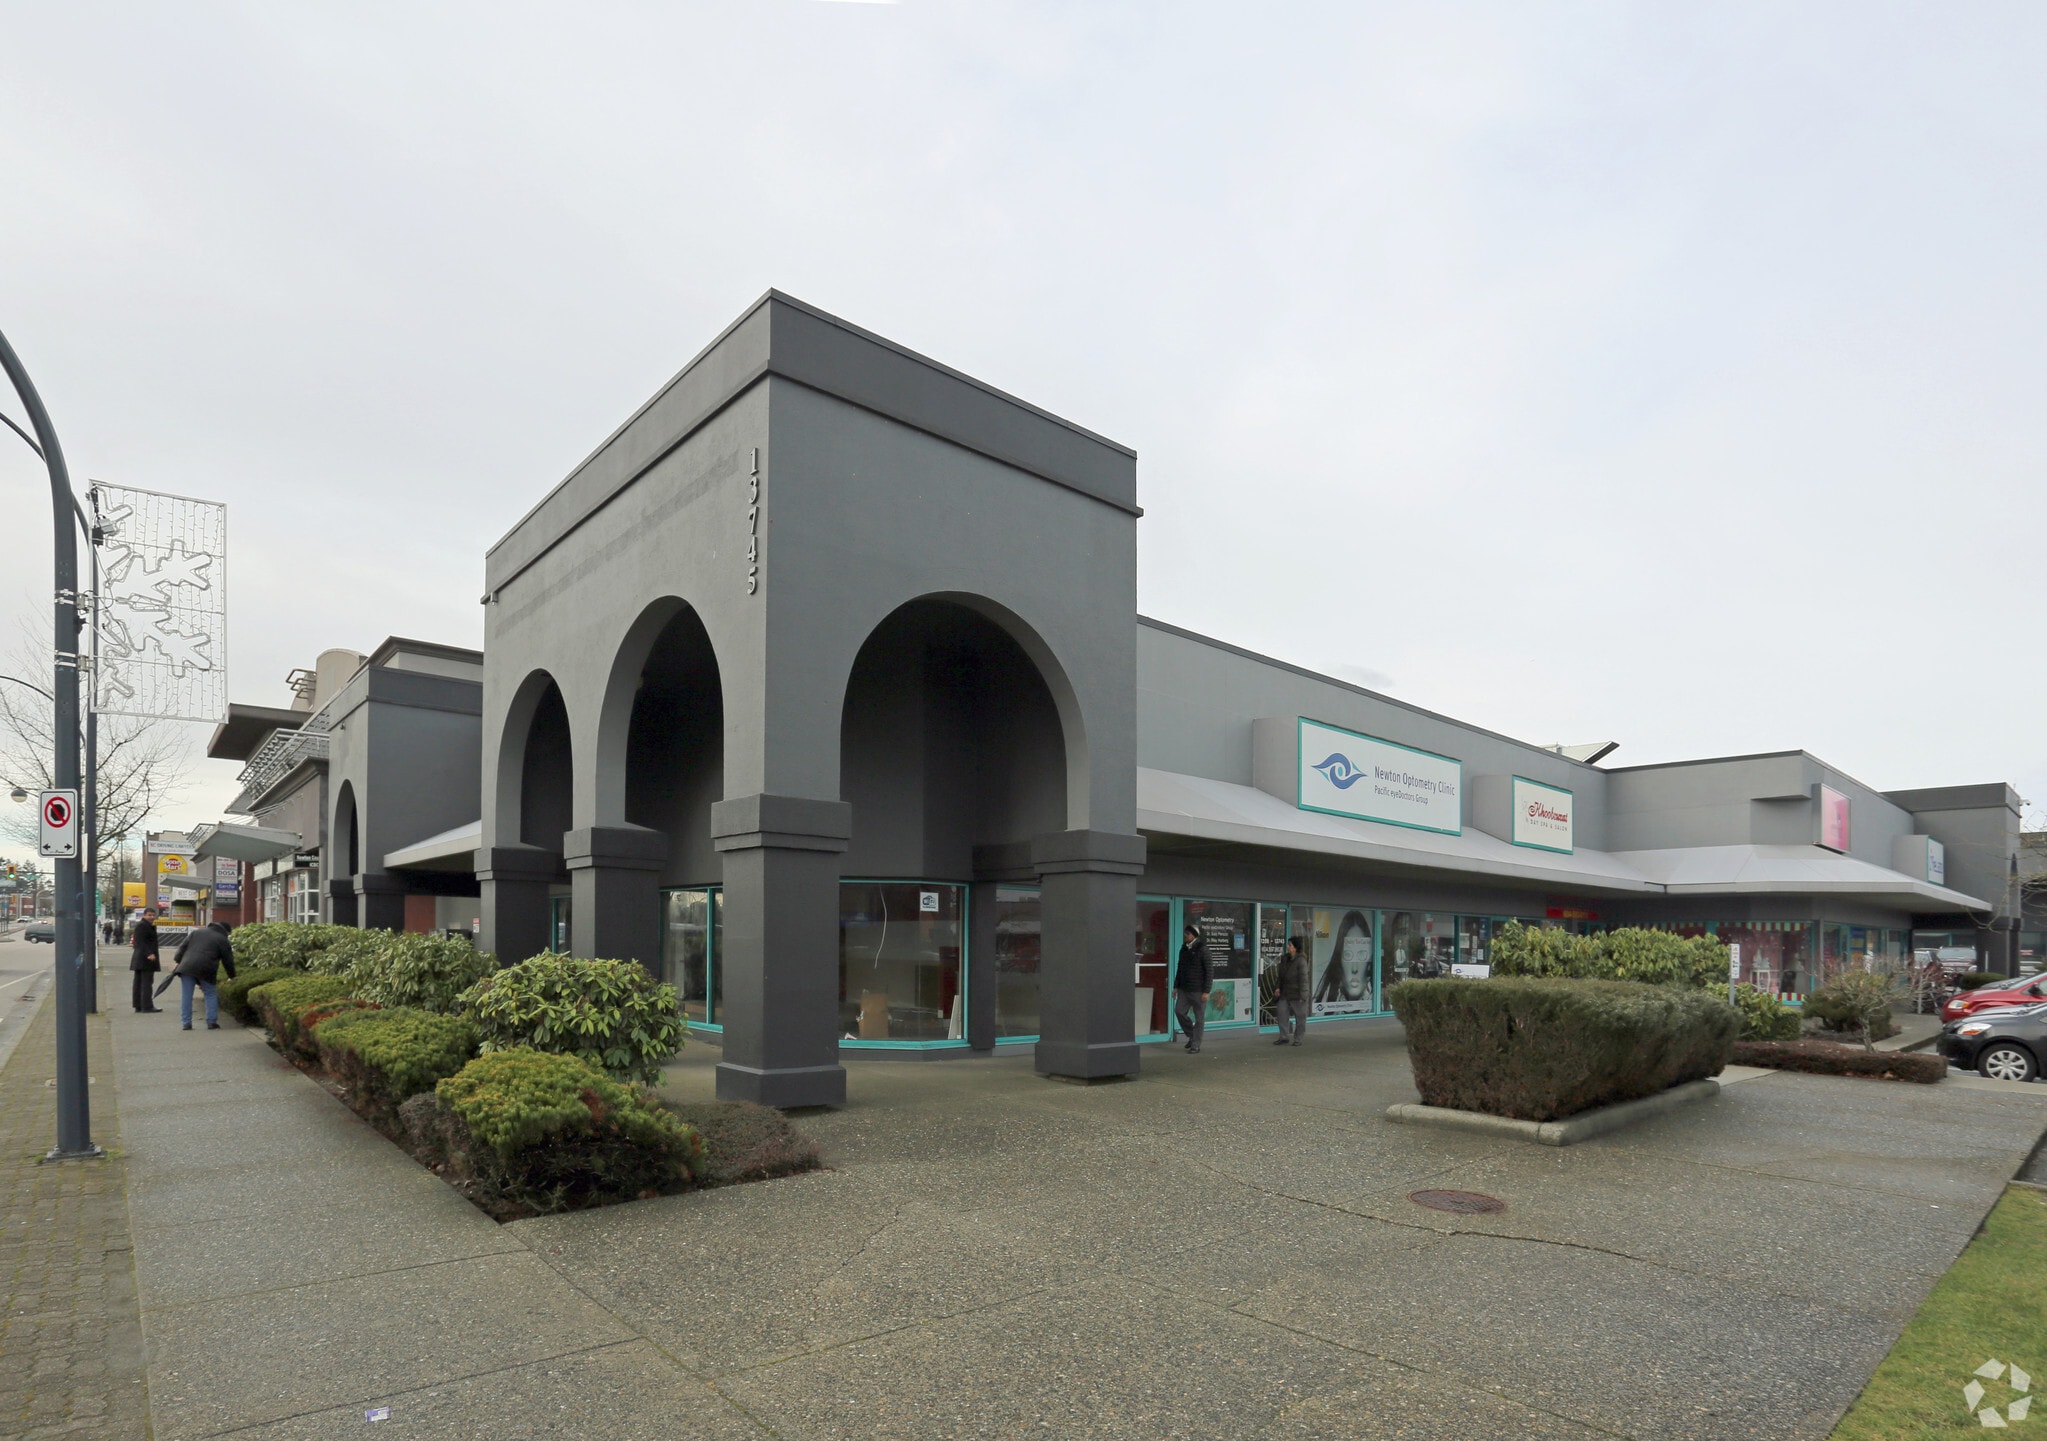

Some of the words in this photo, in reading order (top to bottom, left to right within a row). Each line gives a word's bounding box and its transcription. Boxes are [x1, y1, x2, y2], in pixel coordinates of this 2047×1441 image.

[748, 448, 759, 594] 13745
[1374, 765, 1401, 783] Newton
[1402, 772, 1437, 794] Optometry
[1438, 781, 1455, 796] Clinic
[1374, 784, 1390, 797] Pacific
[1390, 789, 1415, 802] eyeDoctors
[1416, 793, 1429, 805] Group
